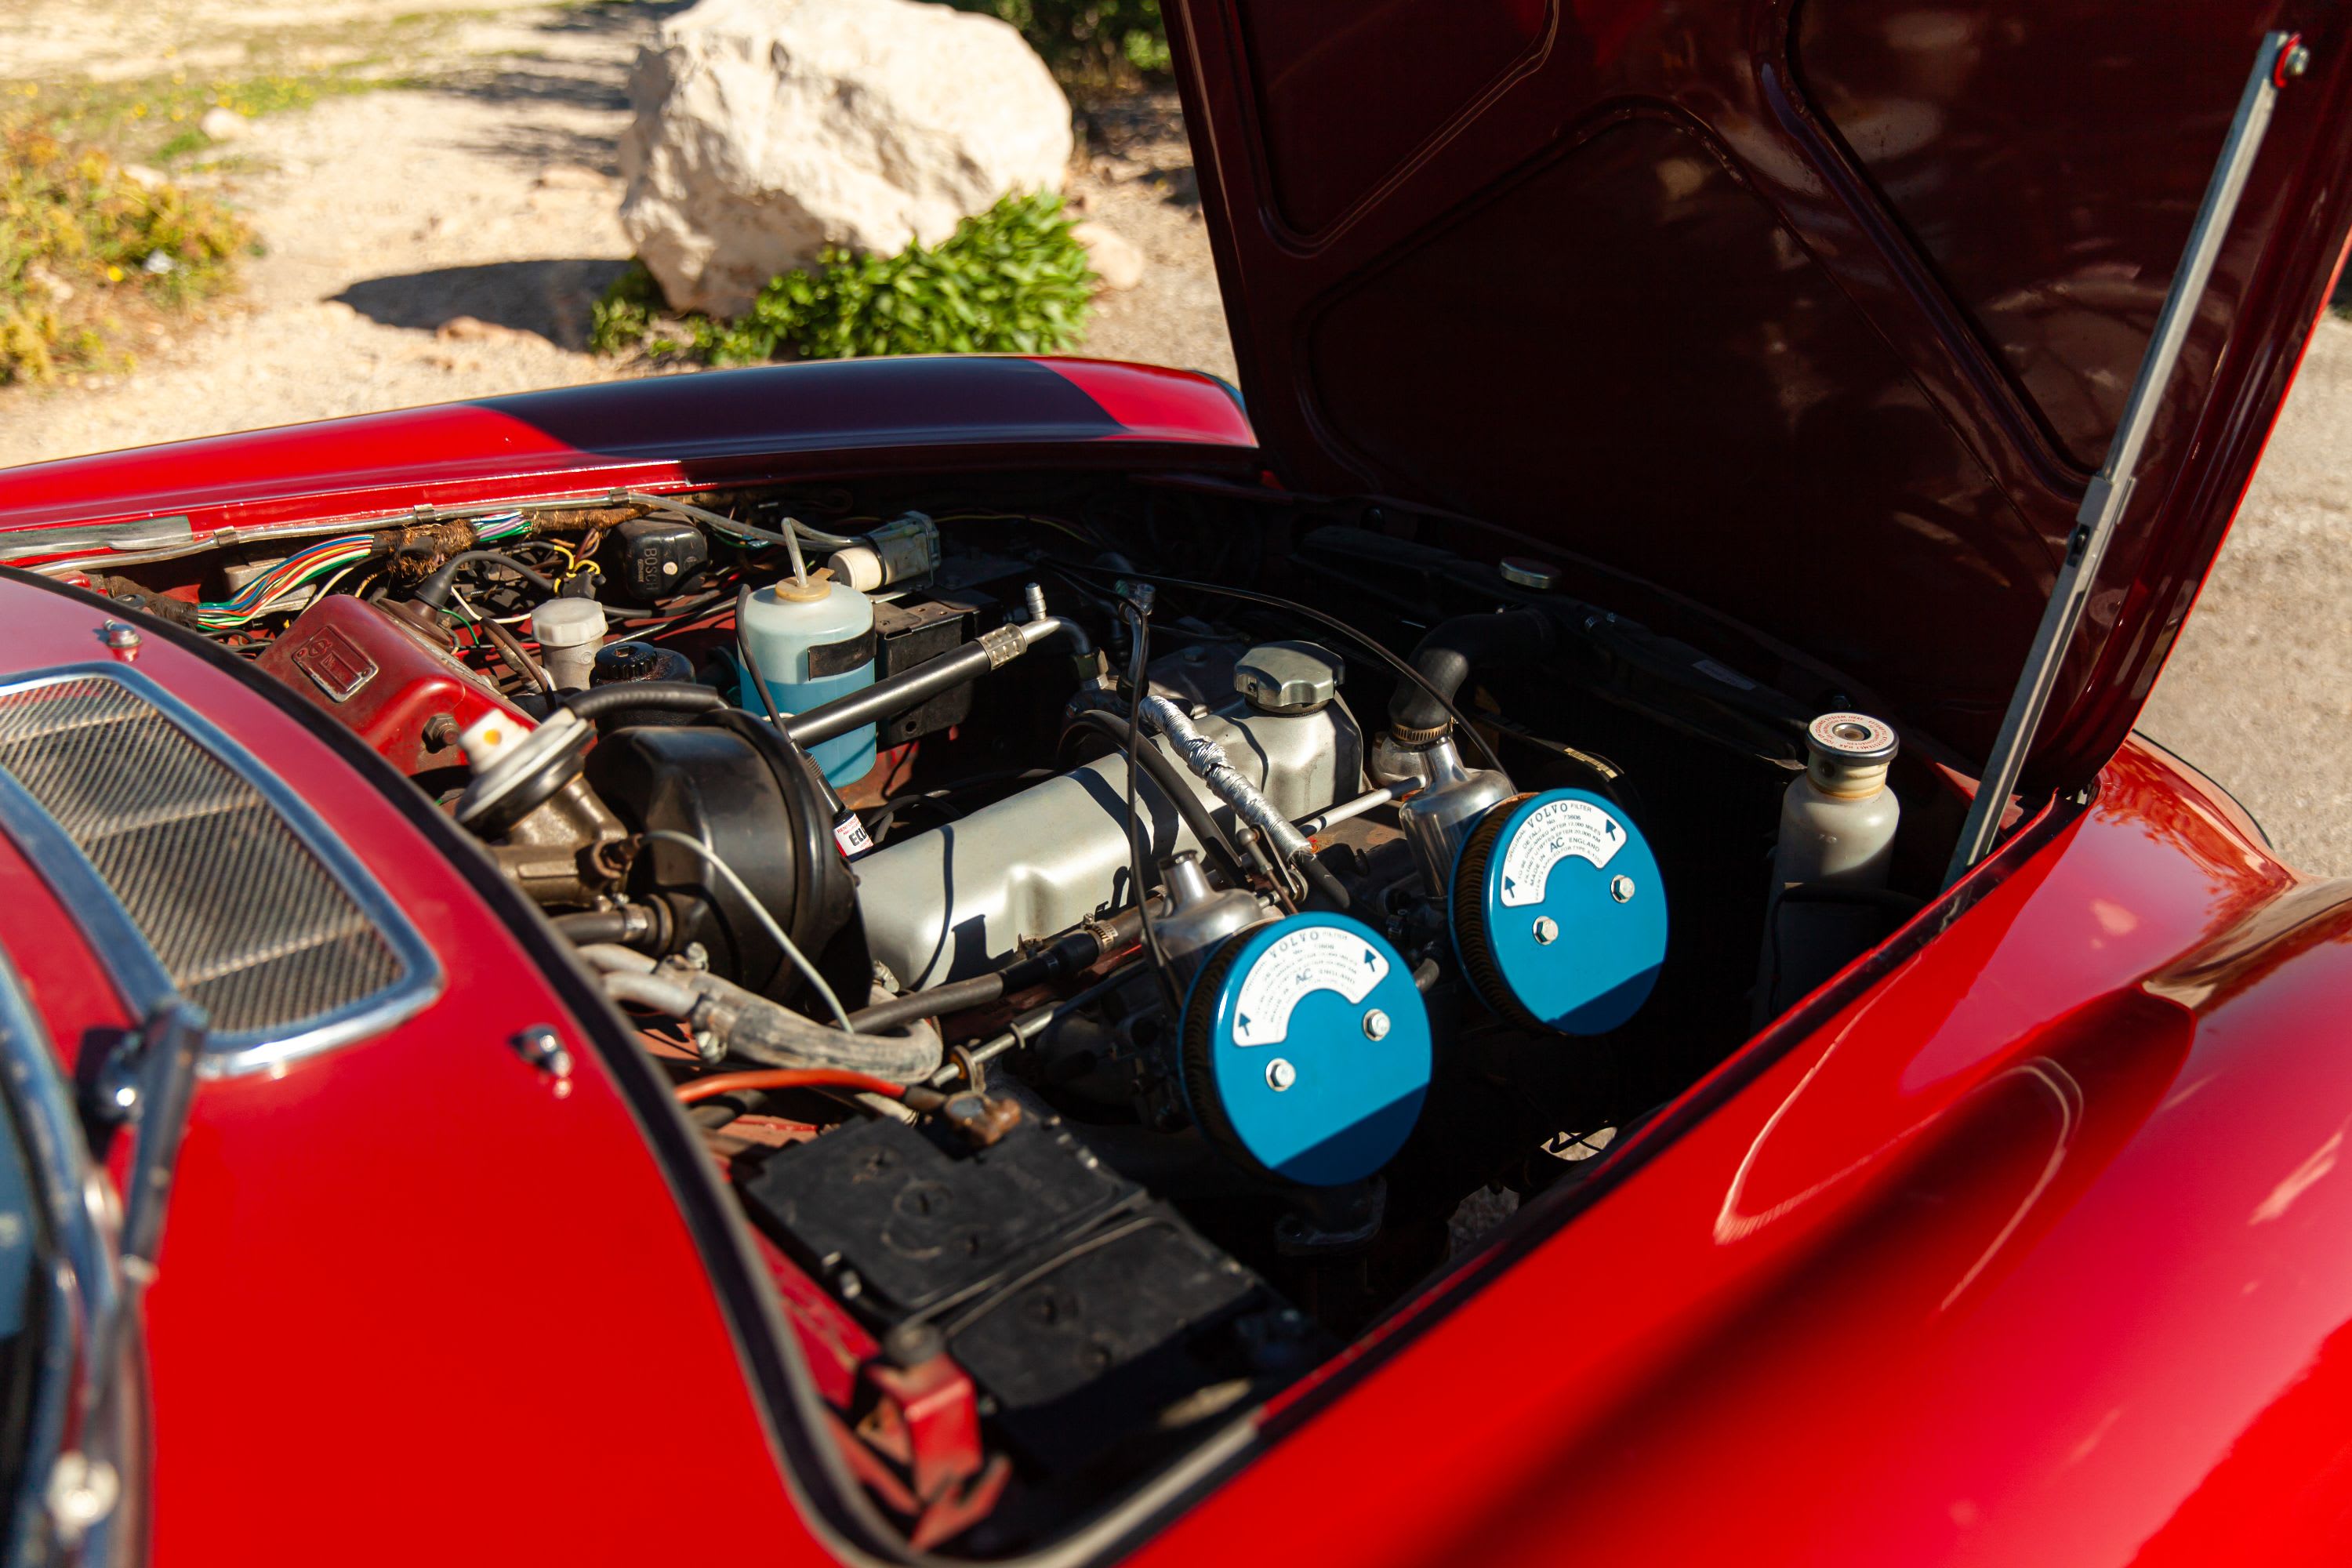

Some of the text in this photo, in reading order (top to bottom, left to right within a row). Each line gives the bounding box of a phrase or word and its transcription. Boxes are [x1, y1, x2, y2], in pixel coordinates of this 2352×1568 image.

[644, 548, 658, 590] BOSCH
[1527, 803, 1568, 829] VOLVO
[1570, 804, 1592, 812] FILTER
[1585, 823, 1602, 837] MILES
[1530, 837, 1600, 887] MADE IN AC ENGLAND
[1269, 931, 1319, 959] VOLVO
